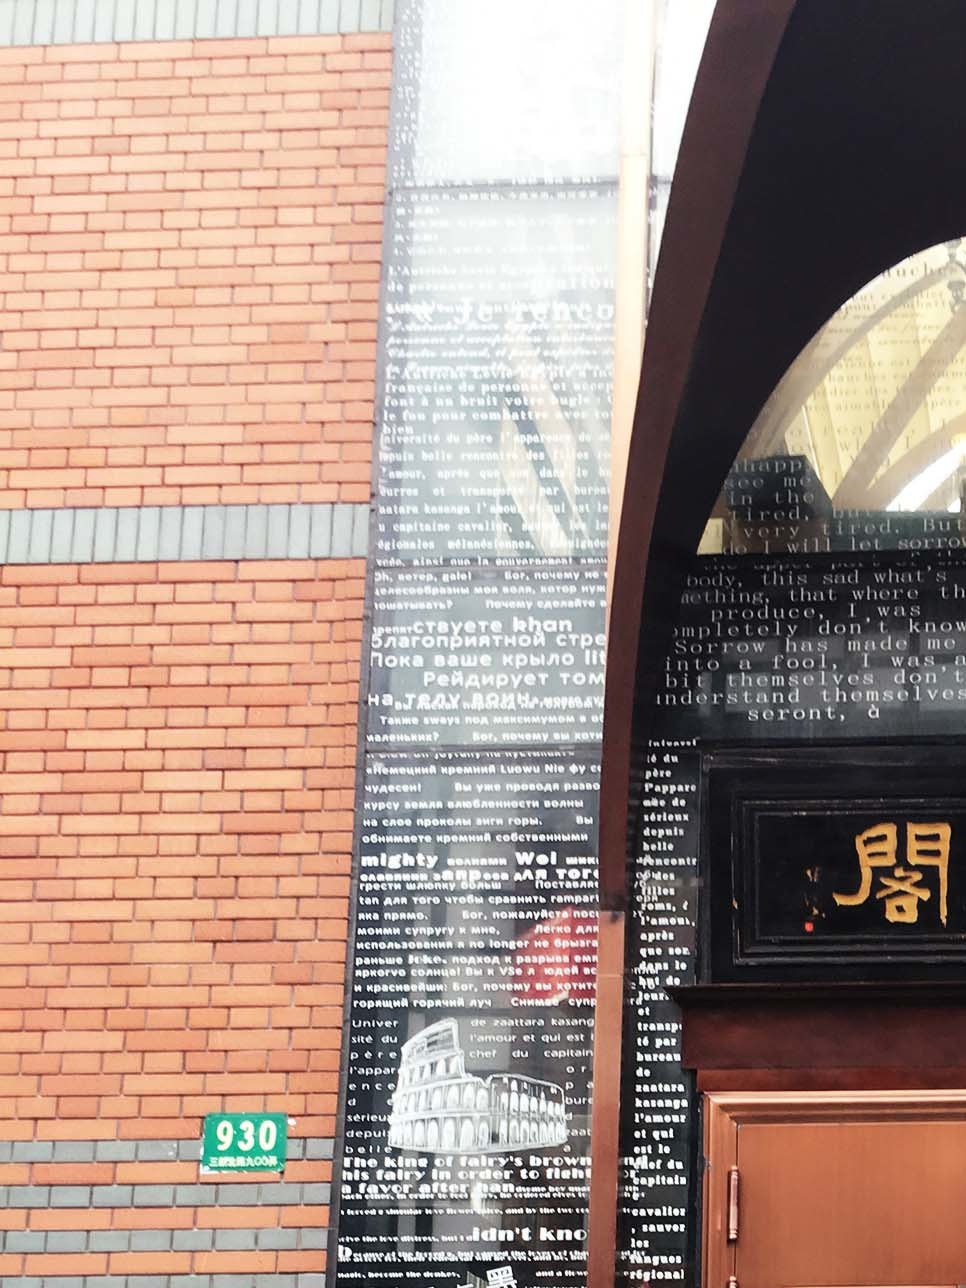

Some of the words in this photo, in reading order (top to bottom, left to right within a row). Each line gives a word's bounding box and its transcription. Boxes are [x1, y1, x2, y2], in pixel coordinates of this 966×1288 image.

[763, 571, 807, 585] this
[822, 570, 858, 584] sad
[874, 568, 946, 584] what's
[790, 587, 836, 602] that
[852, 585, 918, 601] where
[711, 604, 823, 623] produce,
[850, 604, 854, 617] I
[869, 605, 921, 618] was
[818, 619, 890, 637] don't
[674, 639, 765, 654] Sorrow
[785, 638, 827, 653] has
[847, 637, 907, 651] made
[927, 638, 955, 649] me
[370, 652, 423, 668] Пока
[434, 654, 491, 666] ваше
[502, 653, 574, 667] крыло
[666, 656, 719, 671] into
[738, 659, 751, 670] a
[773, 655, 837, 672] fool,
[863, 655, 868, 667] I
[891, 657, 936, 668] was
[954, 655, 966, 665] a
[423, 671, 549, 688] Рейдирует
[666, 672, 703, 688] bit
[726, 670, 873, 689] themselves
[894, 669, 963, 687] don't
[747, 705, 844, 722] seront,
[867, 704, 879, 718] à
[360, 852, 438, 869] mighty
[216, 1119, 277, 1152] 930
